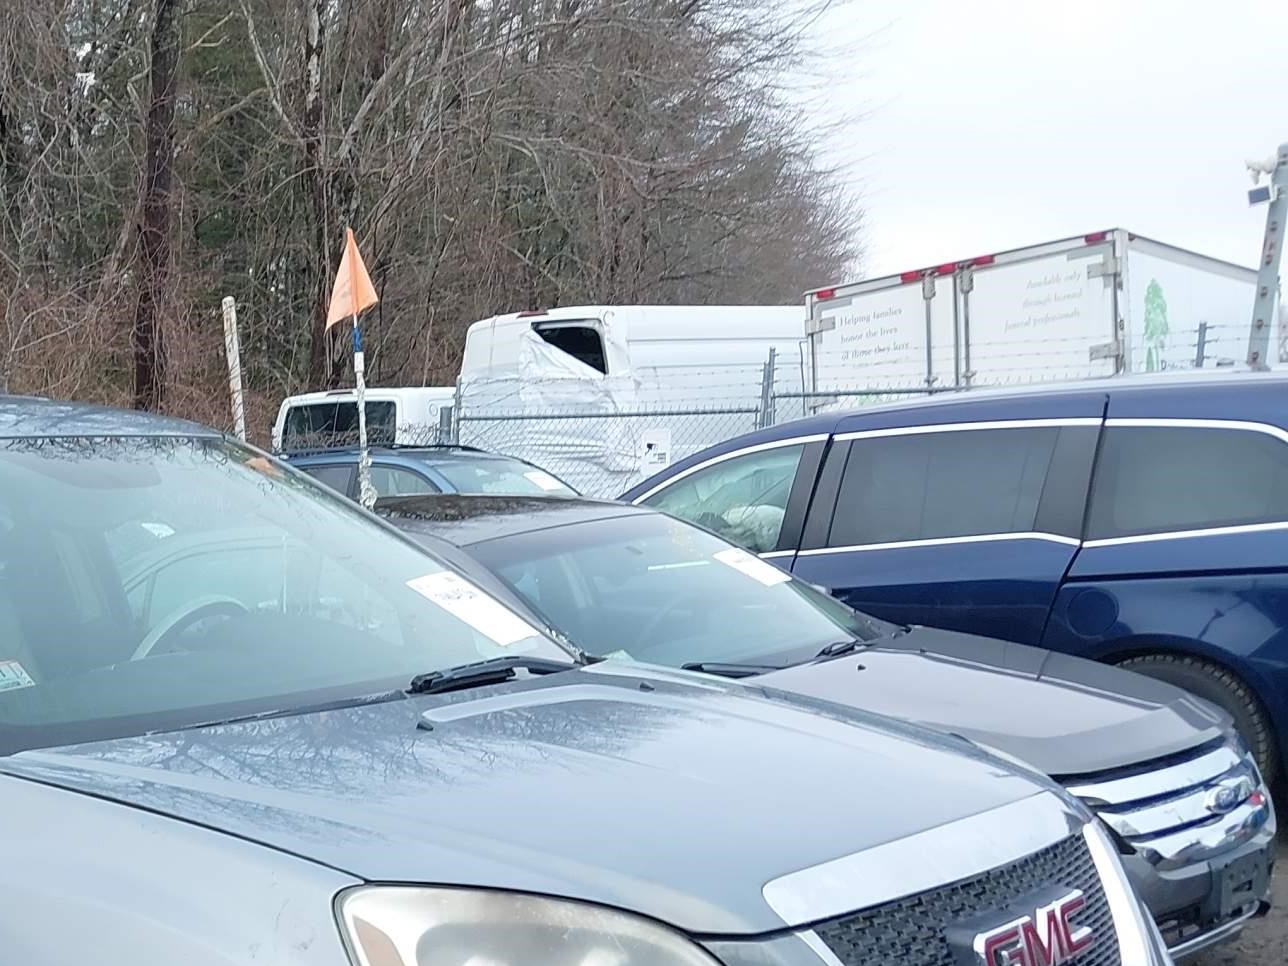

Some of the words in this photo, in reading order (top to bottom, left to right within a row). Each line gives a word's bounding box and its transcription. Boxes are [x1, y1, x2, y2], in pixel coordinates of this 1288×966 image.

[840, 312, 871, 326] Helping
[873, 306, 902, 319] families
[866, 328, 878, 338] the
